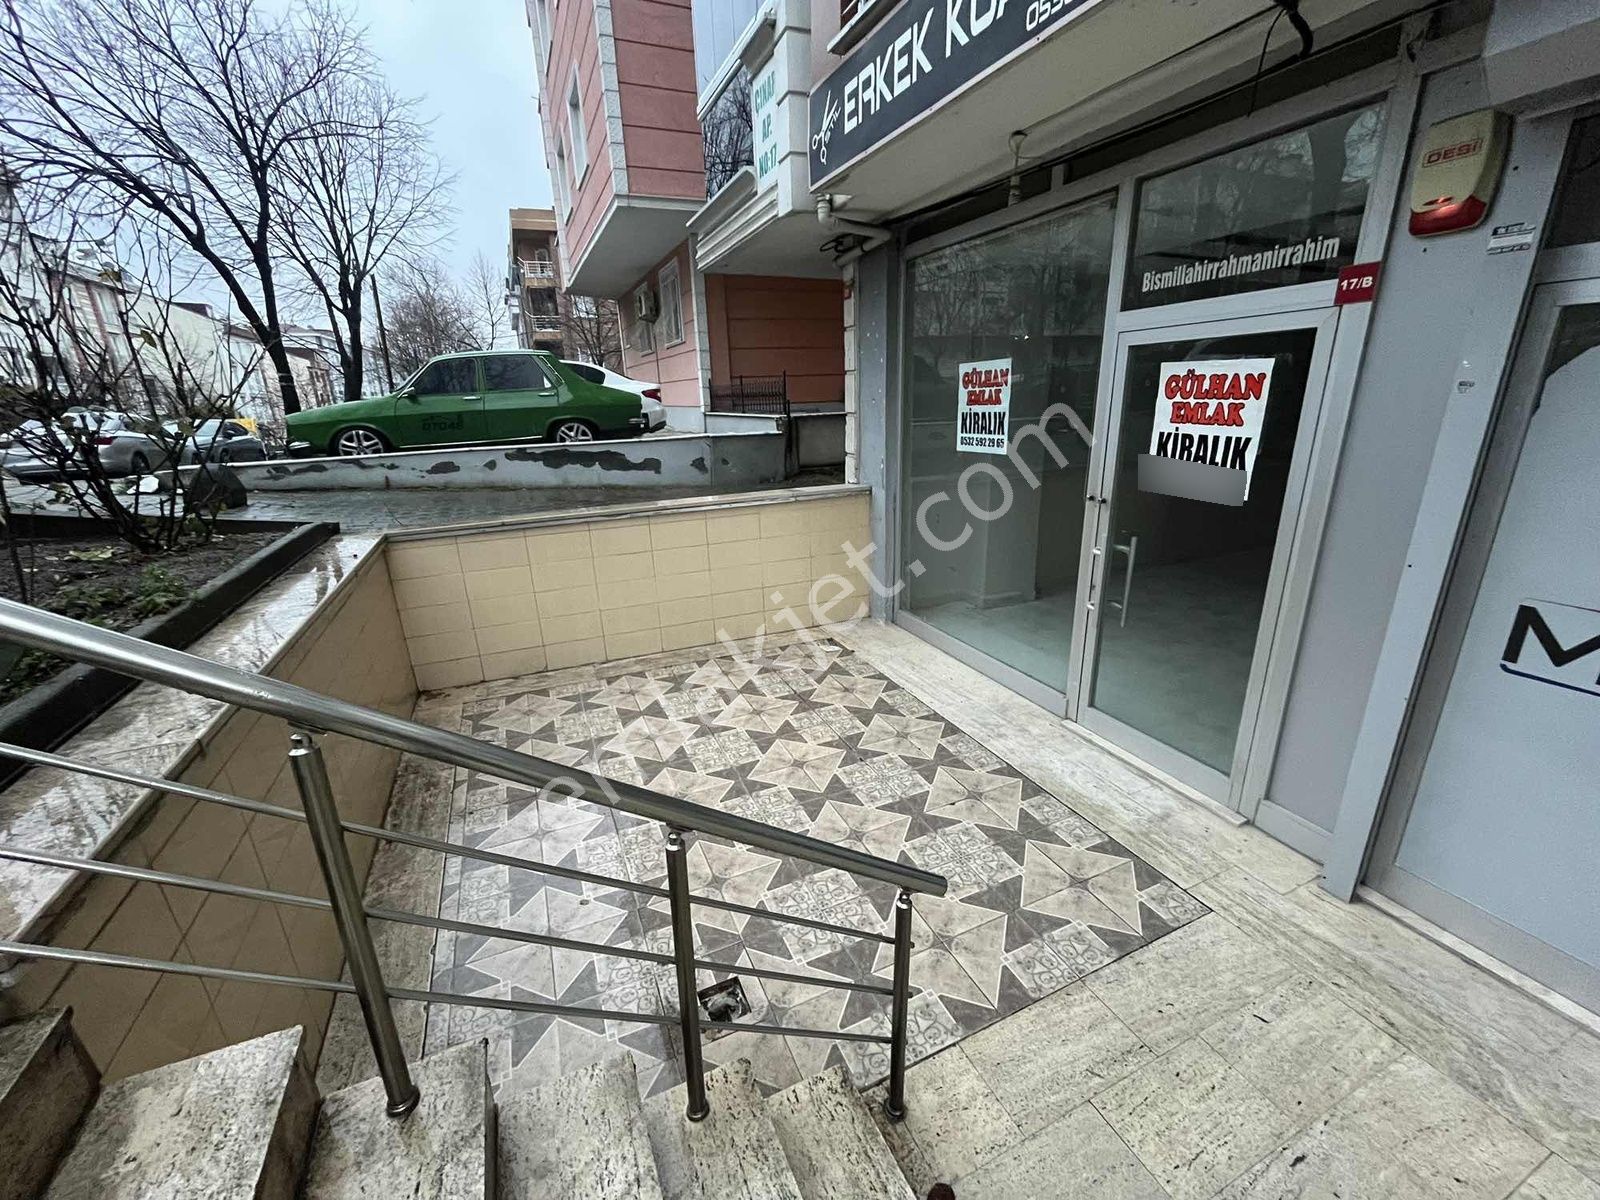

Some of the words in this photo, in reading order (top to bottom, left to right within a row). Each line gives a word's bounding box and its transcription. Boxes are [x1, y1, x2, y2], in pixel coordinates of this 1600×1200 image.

[844, 7, 934, 135] ERKEK
[1142, 235, 1340, 293] Bismillahirrahmanirrahim
[1341, 275, 1374, 291] 17/B
[962, 368, 1010, 390] GÜLHAN
[1164, 368, 1267, 400] GÜLHAN
[966, 389, 1003, 406] EMLAK
[961, 408, 1006, 435] KİRALIK
[1170, 402, 1245, 426] EMLAK
[976, 437, 987, 447] 592
[1157, 427, 1252, 472] KİRALIK
